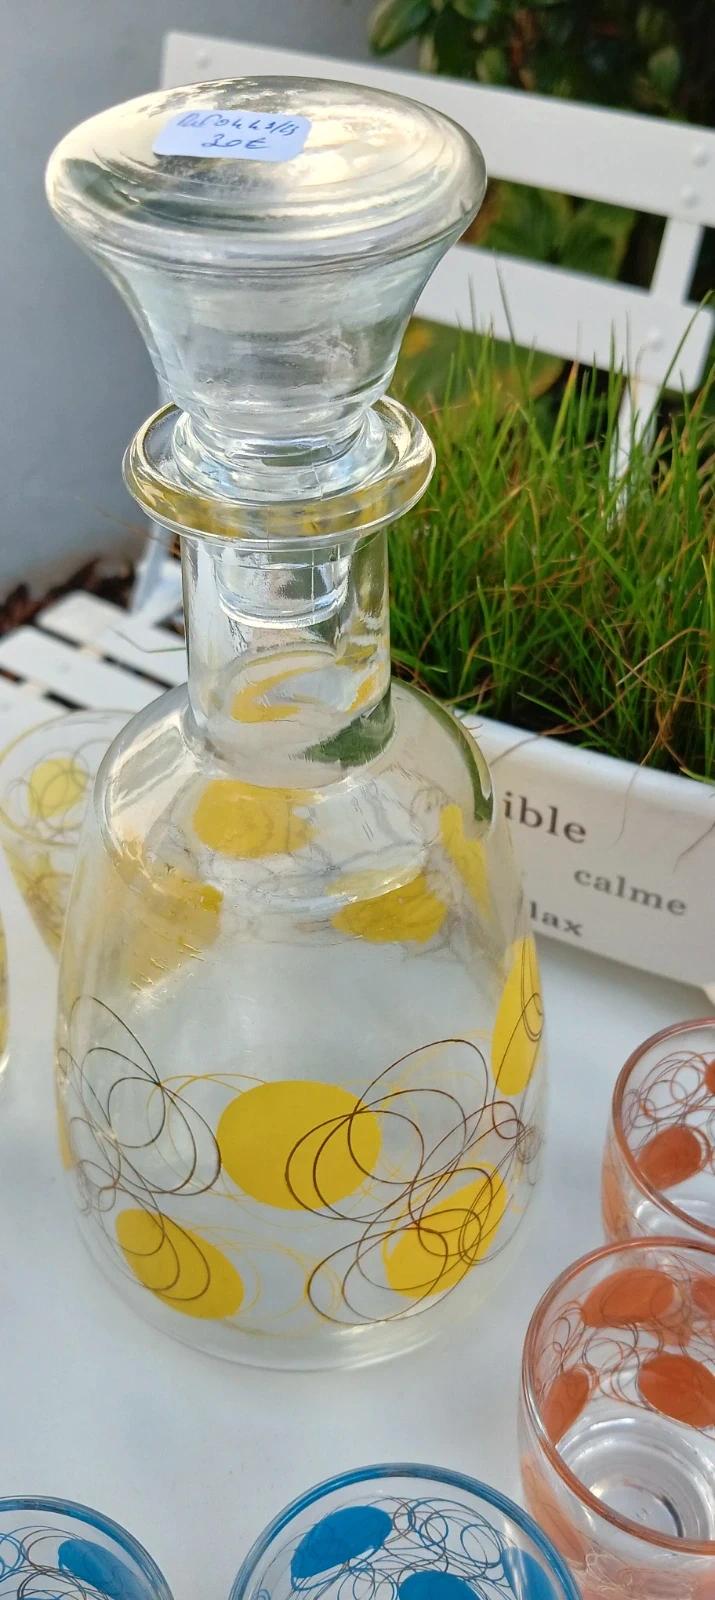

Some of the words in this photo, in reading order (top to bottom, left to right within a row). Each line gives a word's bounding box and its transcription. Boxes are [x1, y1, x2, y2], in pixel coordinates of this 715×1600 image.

[503, 790, 587, 843] ible
[573, 868, 687, 916] calme
[529, 900, 583, 937] lax
